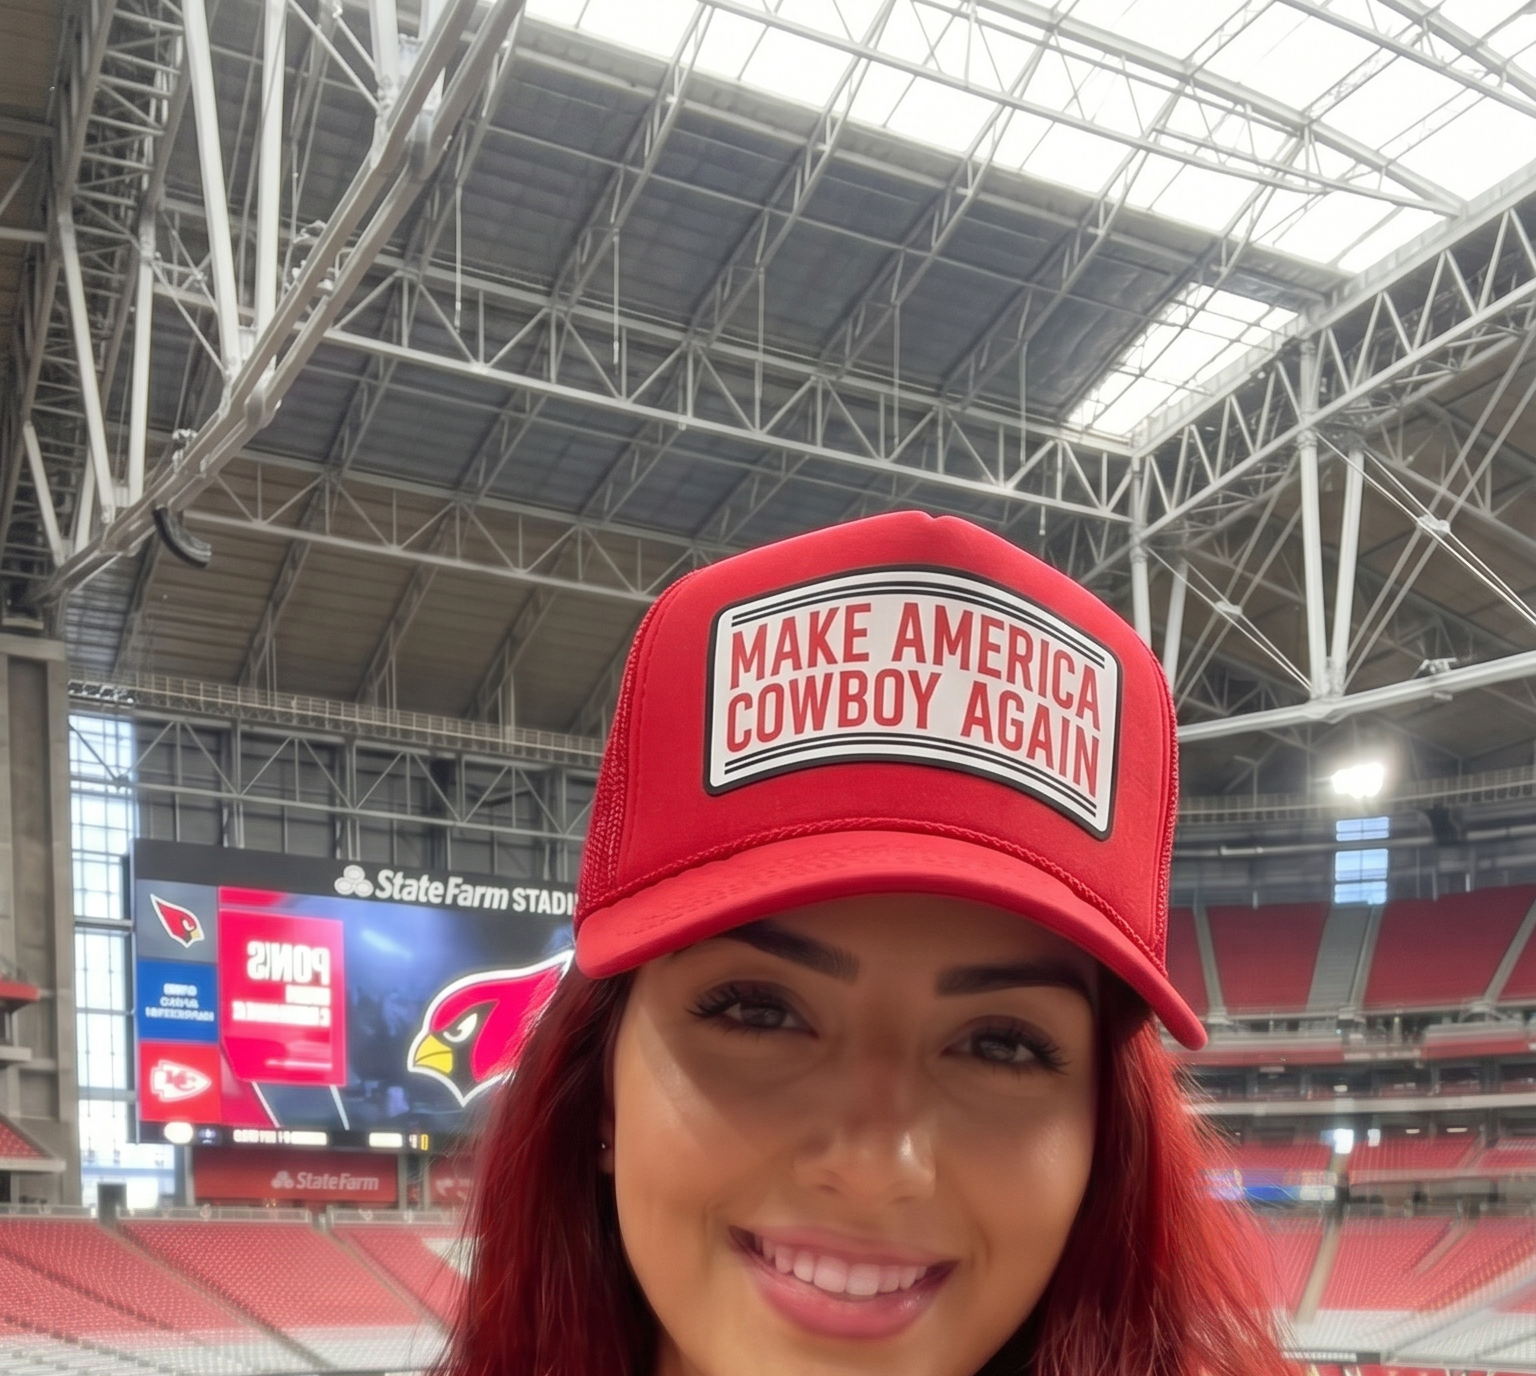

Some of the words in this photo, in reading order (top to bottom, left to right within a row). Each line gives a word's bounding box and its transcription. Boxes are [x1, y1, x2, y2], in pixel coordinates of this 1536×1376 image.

[729, 602, 872, 691] MAKE
[891, 601, 1101, 732] AMERICA
[726, 667, 942, 753] COWBOY
[960, 680, 1100, 798] AGAIN
[512, 887, 579, 916] STADI
